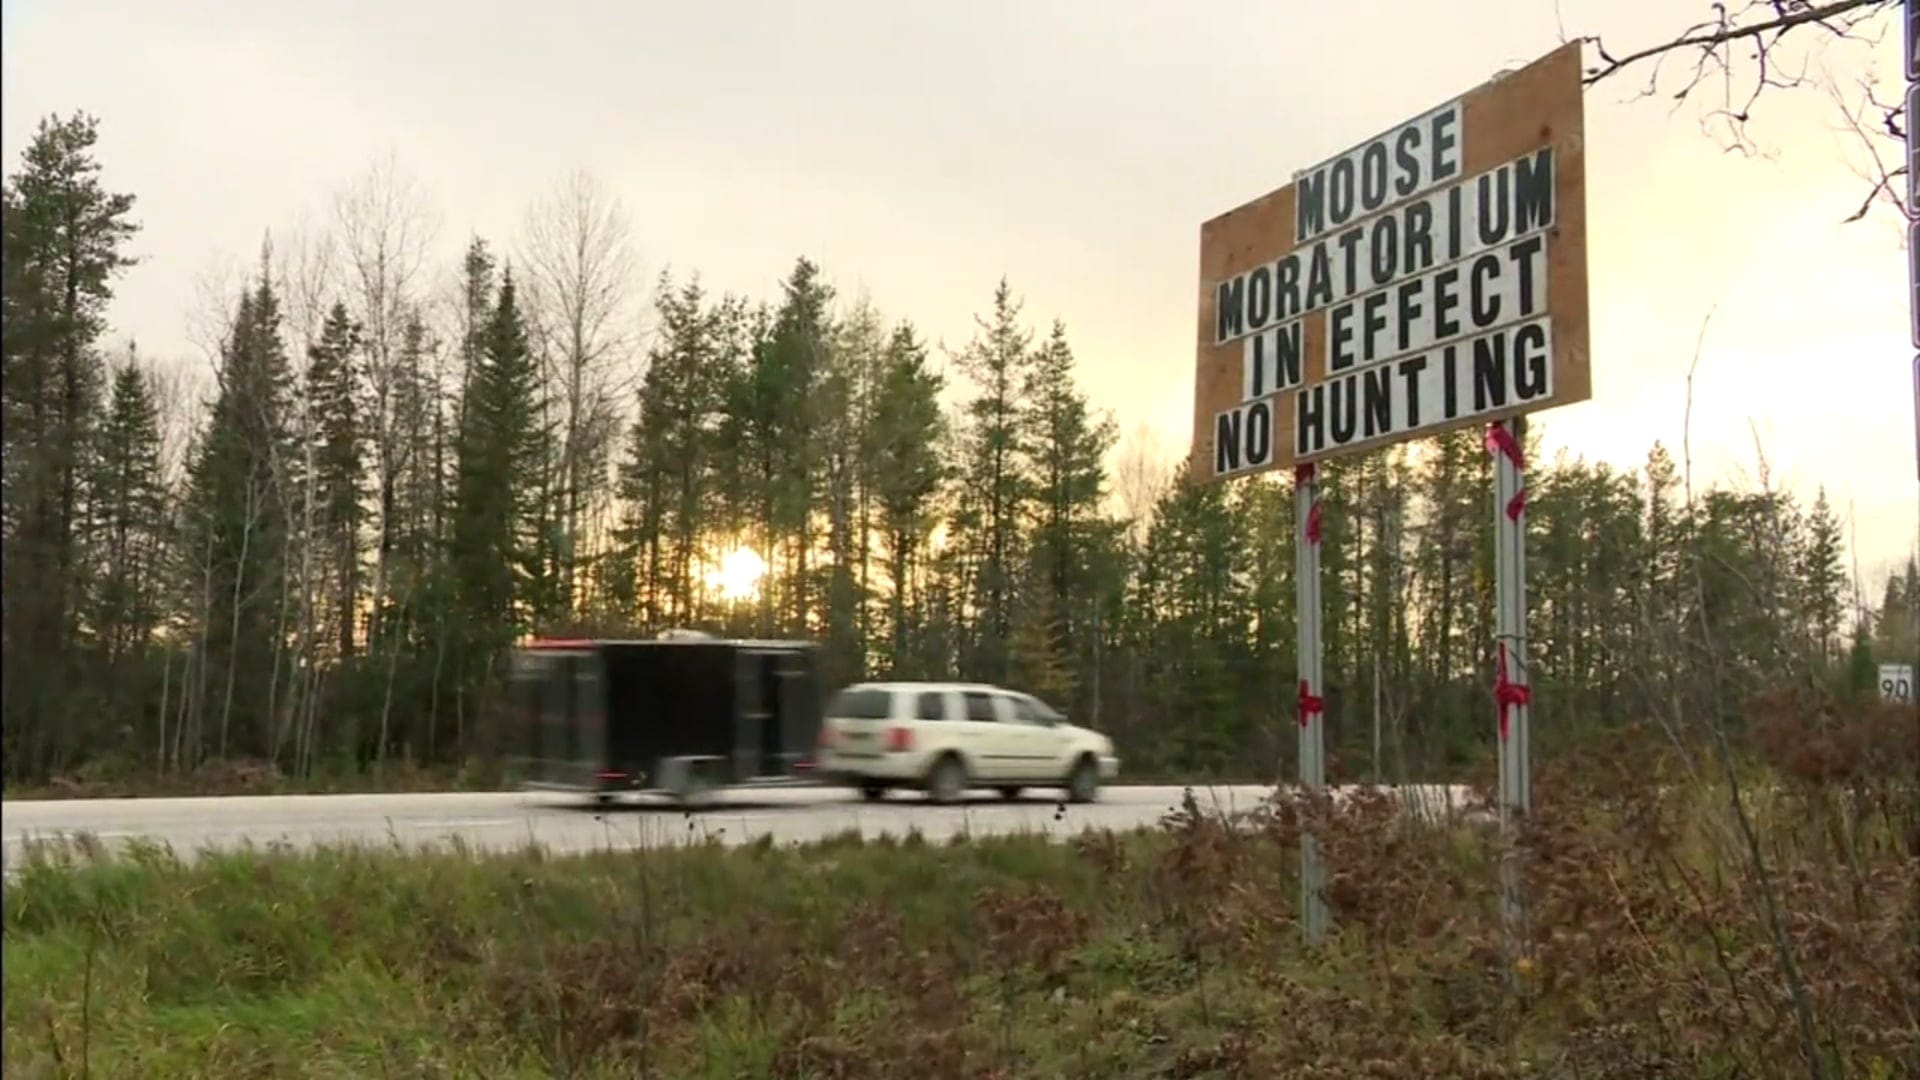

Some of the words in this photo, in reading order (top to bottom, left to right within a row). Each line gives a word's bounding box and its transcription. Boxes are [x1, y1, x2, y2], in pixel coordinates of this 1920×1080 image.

[1217, 147, 1552, 341] MORATORIUM
[1297, 110, 1456, 243] MOOSE
[1252, 323, 1300, 397] IN
[1330, 236, 1542, 371] EFFECT
[1217, 402, 1270, 473] NO
[1298, 324, 1547, 455] HUNTING
[1882, 679, 1909, 698] 90
